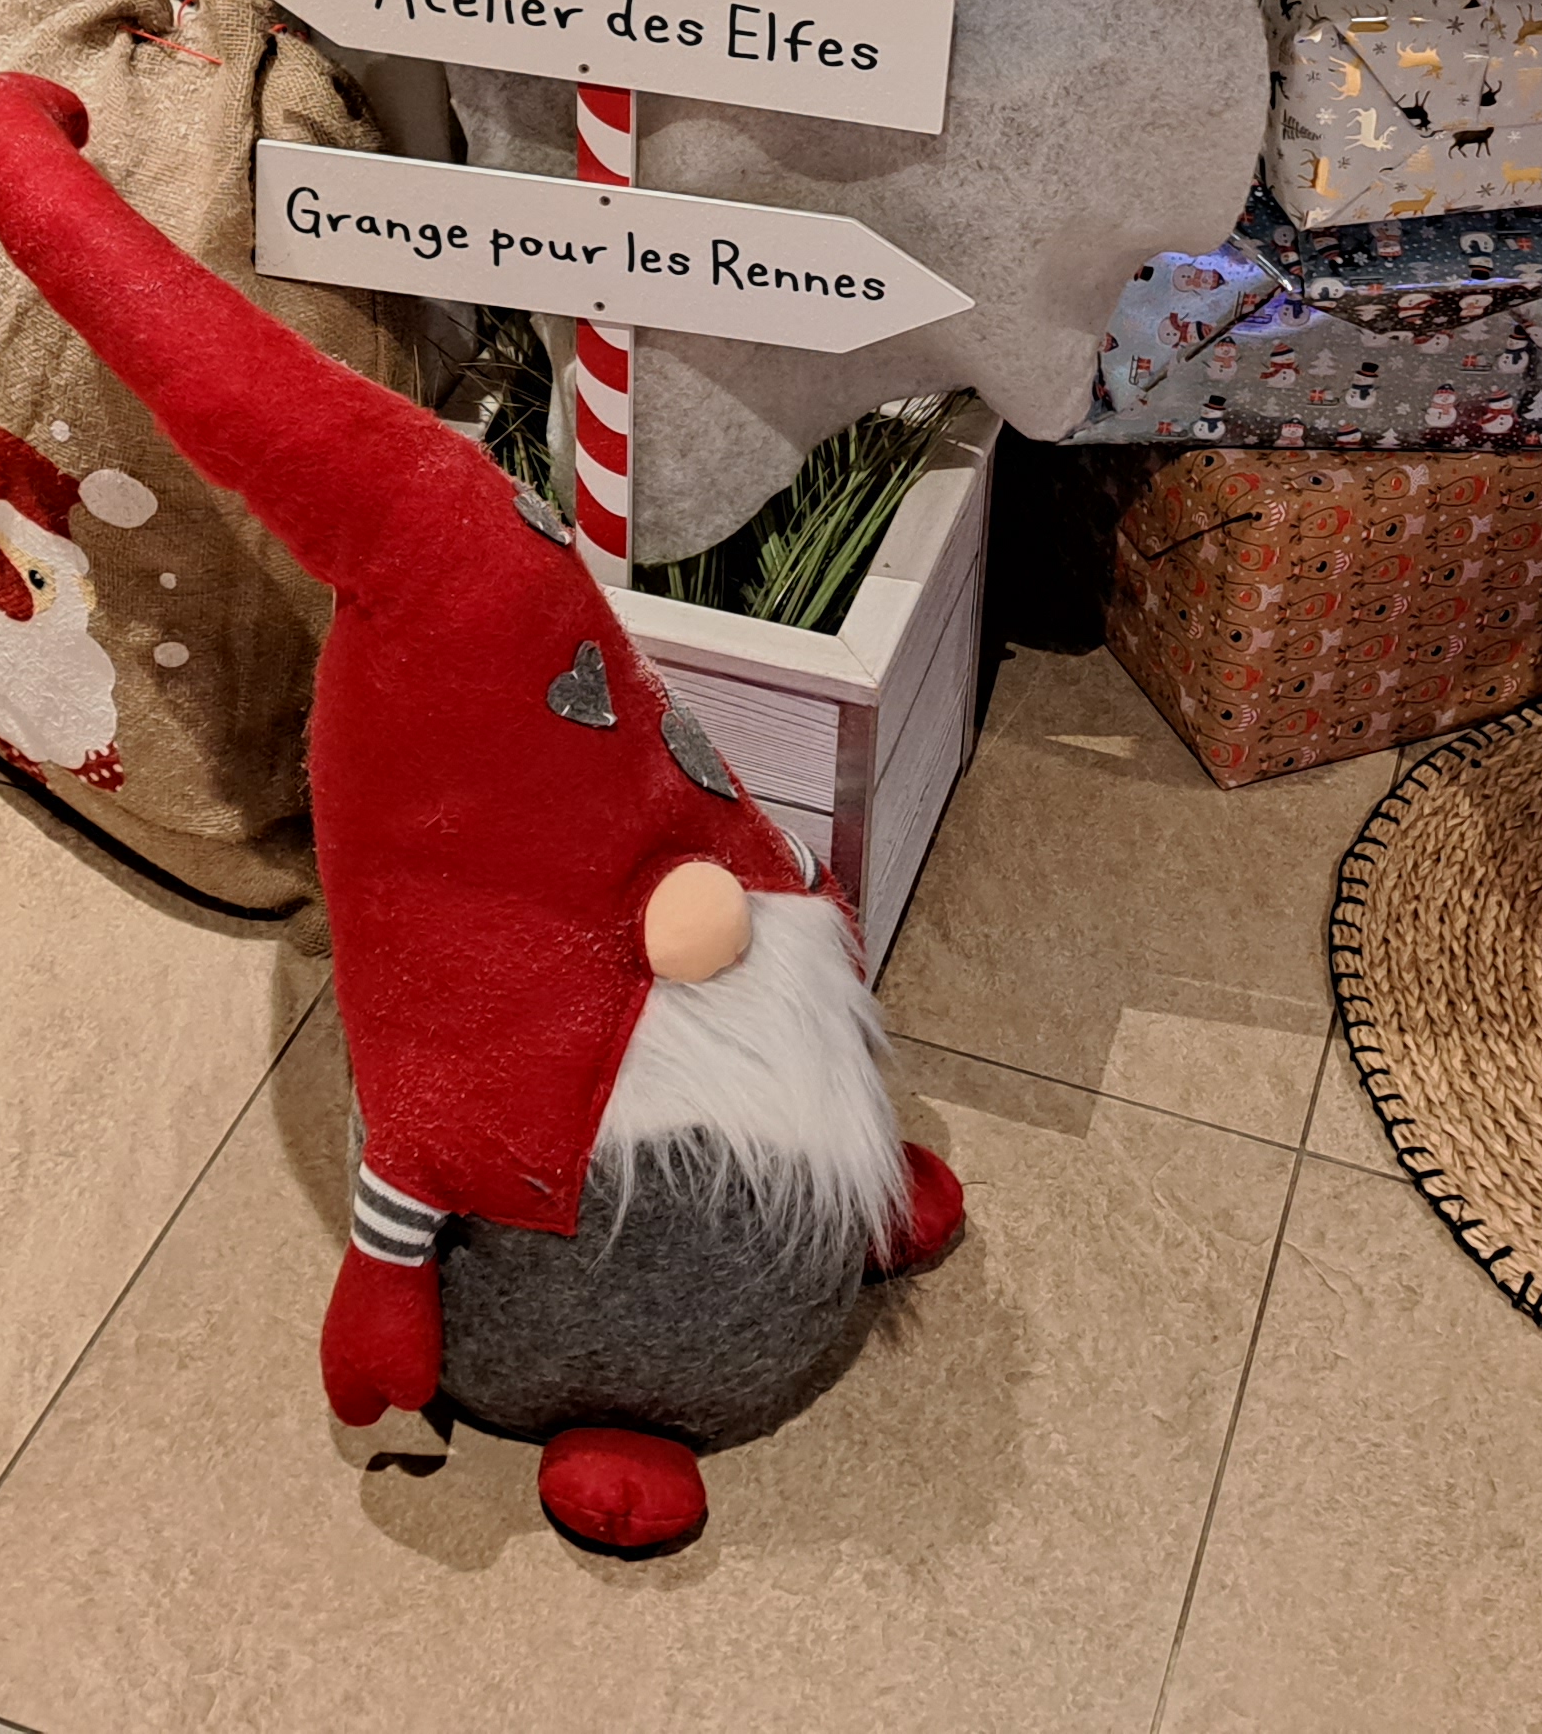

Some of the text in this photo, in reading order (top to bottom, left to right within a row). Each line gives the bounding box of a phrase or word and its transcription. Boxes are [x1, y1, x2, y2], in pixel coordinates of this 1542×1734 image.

[727, 3, 880, 71] Elfes
[285, 186, 887, 302] Grange pour les Rennes
